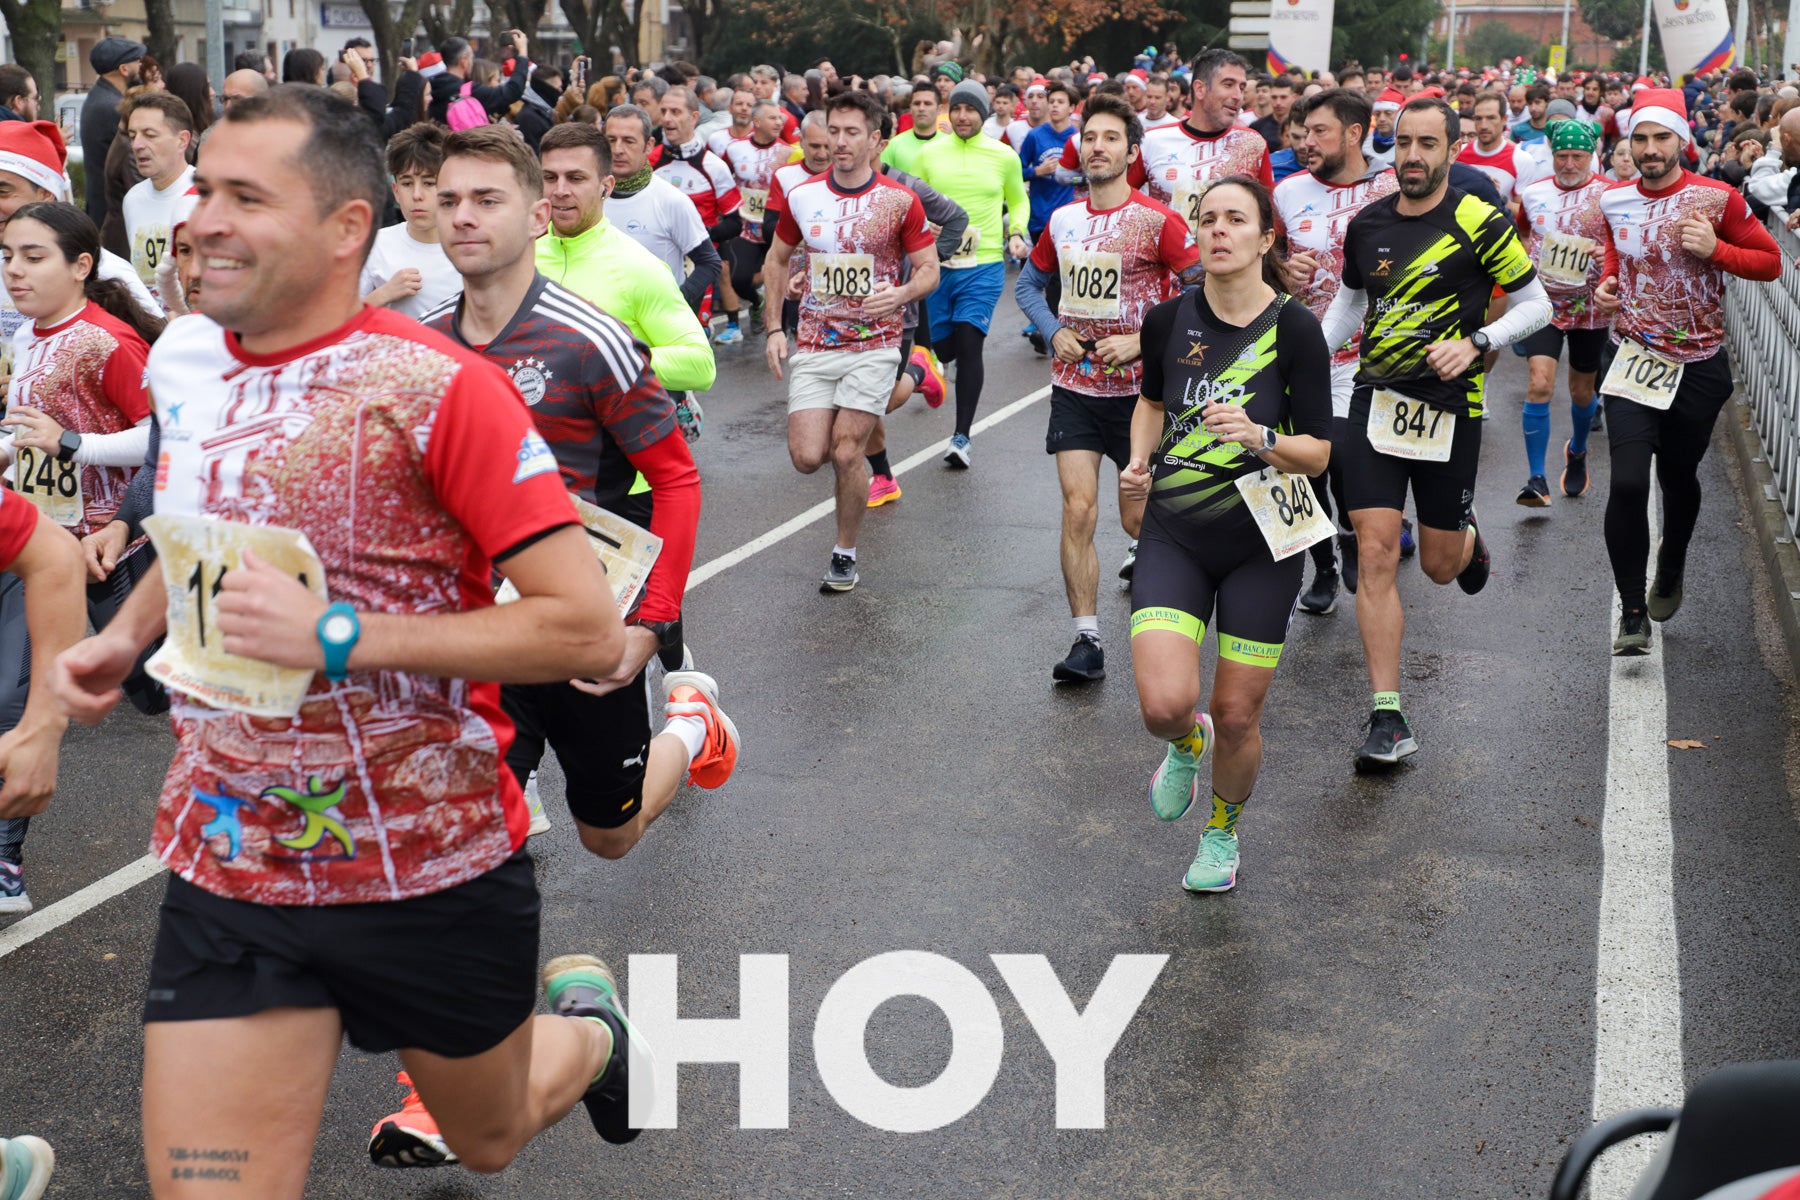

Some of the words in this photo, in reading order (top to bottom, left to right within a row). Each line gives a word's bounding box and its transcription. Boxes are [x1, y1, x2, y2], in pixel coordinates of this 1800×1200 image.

[750, 197, 763, 211] 94
[1551, 244, 1590, 272] 1110
[823, 267, 871, 296] 1083
[1069, 265, 1118, 299] 1082
[1624, 354, 1680, 394] 1024
[1393, 401, 1443, 439] 847
[1271, 476, 1313, 527] 848
[1155, 610, 1180, 620] PUEYO
[1243, 643, 1265, 655] BANCA
